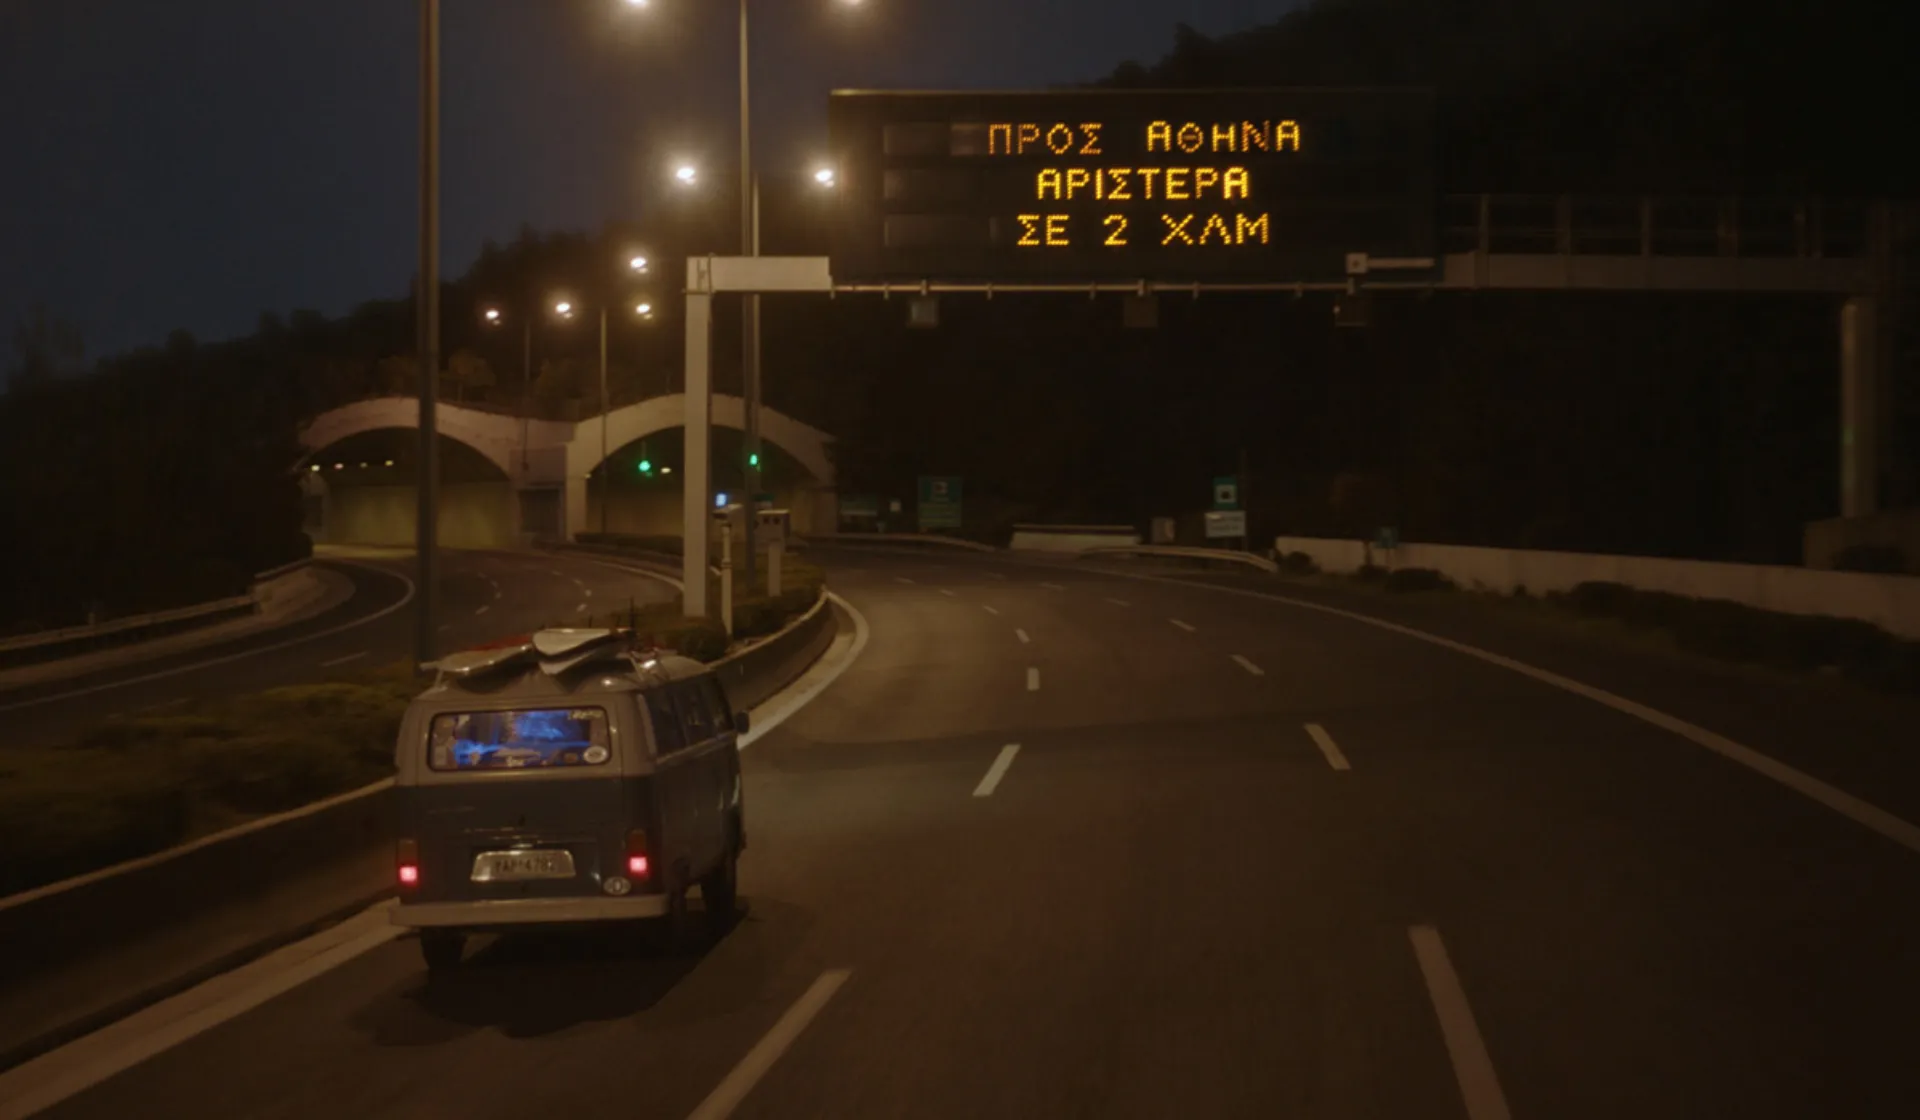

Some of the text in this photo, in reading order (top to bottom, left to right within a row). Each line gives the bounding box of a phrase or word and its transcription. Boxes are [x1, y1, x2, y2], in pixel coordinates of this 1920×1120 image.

[987, 119, 1301, 155] ΠΡΟΣ ΑΘΗΝΑ
[1035, 165, 1249, 201] ΑΡΙΣΤΕΡΑ
[1015, 211, 1269, 246] ΣΕ 2 ΧΛΜ
